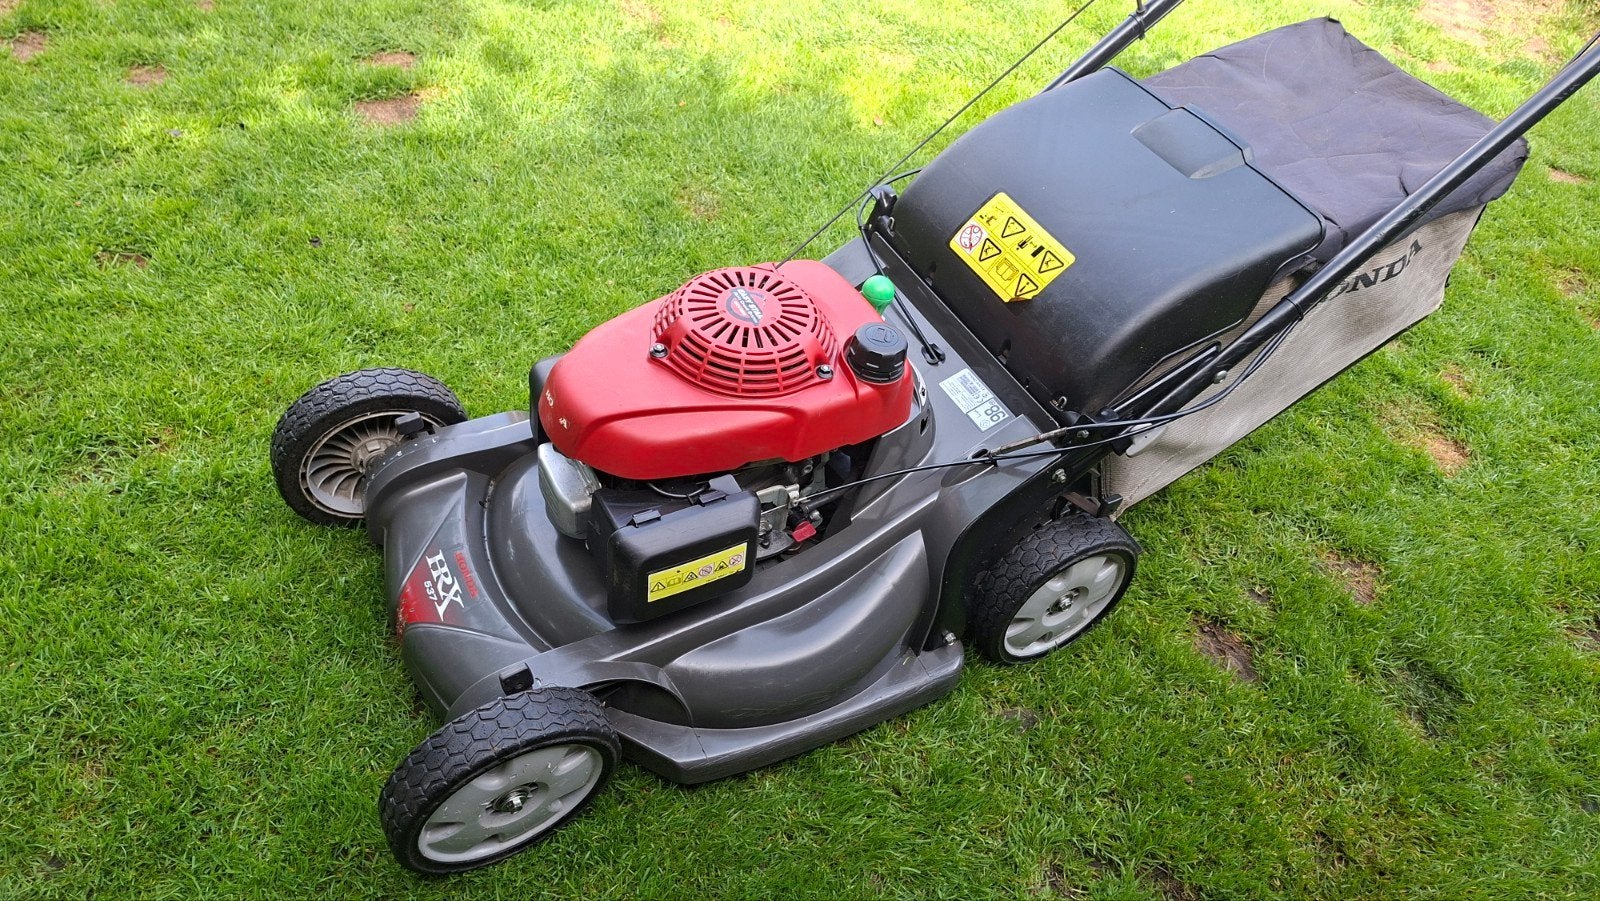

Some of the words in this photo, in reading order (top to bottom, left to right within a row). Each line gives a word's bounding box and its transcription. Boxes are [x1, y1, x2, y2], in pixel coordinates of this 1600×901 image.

[1320, 239, 1422, 302] ONDA
[424, 581, 438, 601] 537
[425, 549, 465, 622] HRX
[454, 551, 479, 599] HONDA
